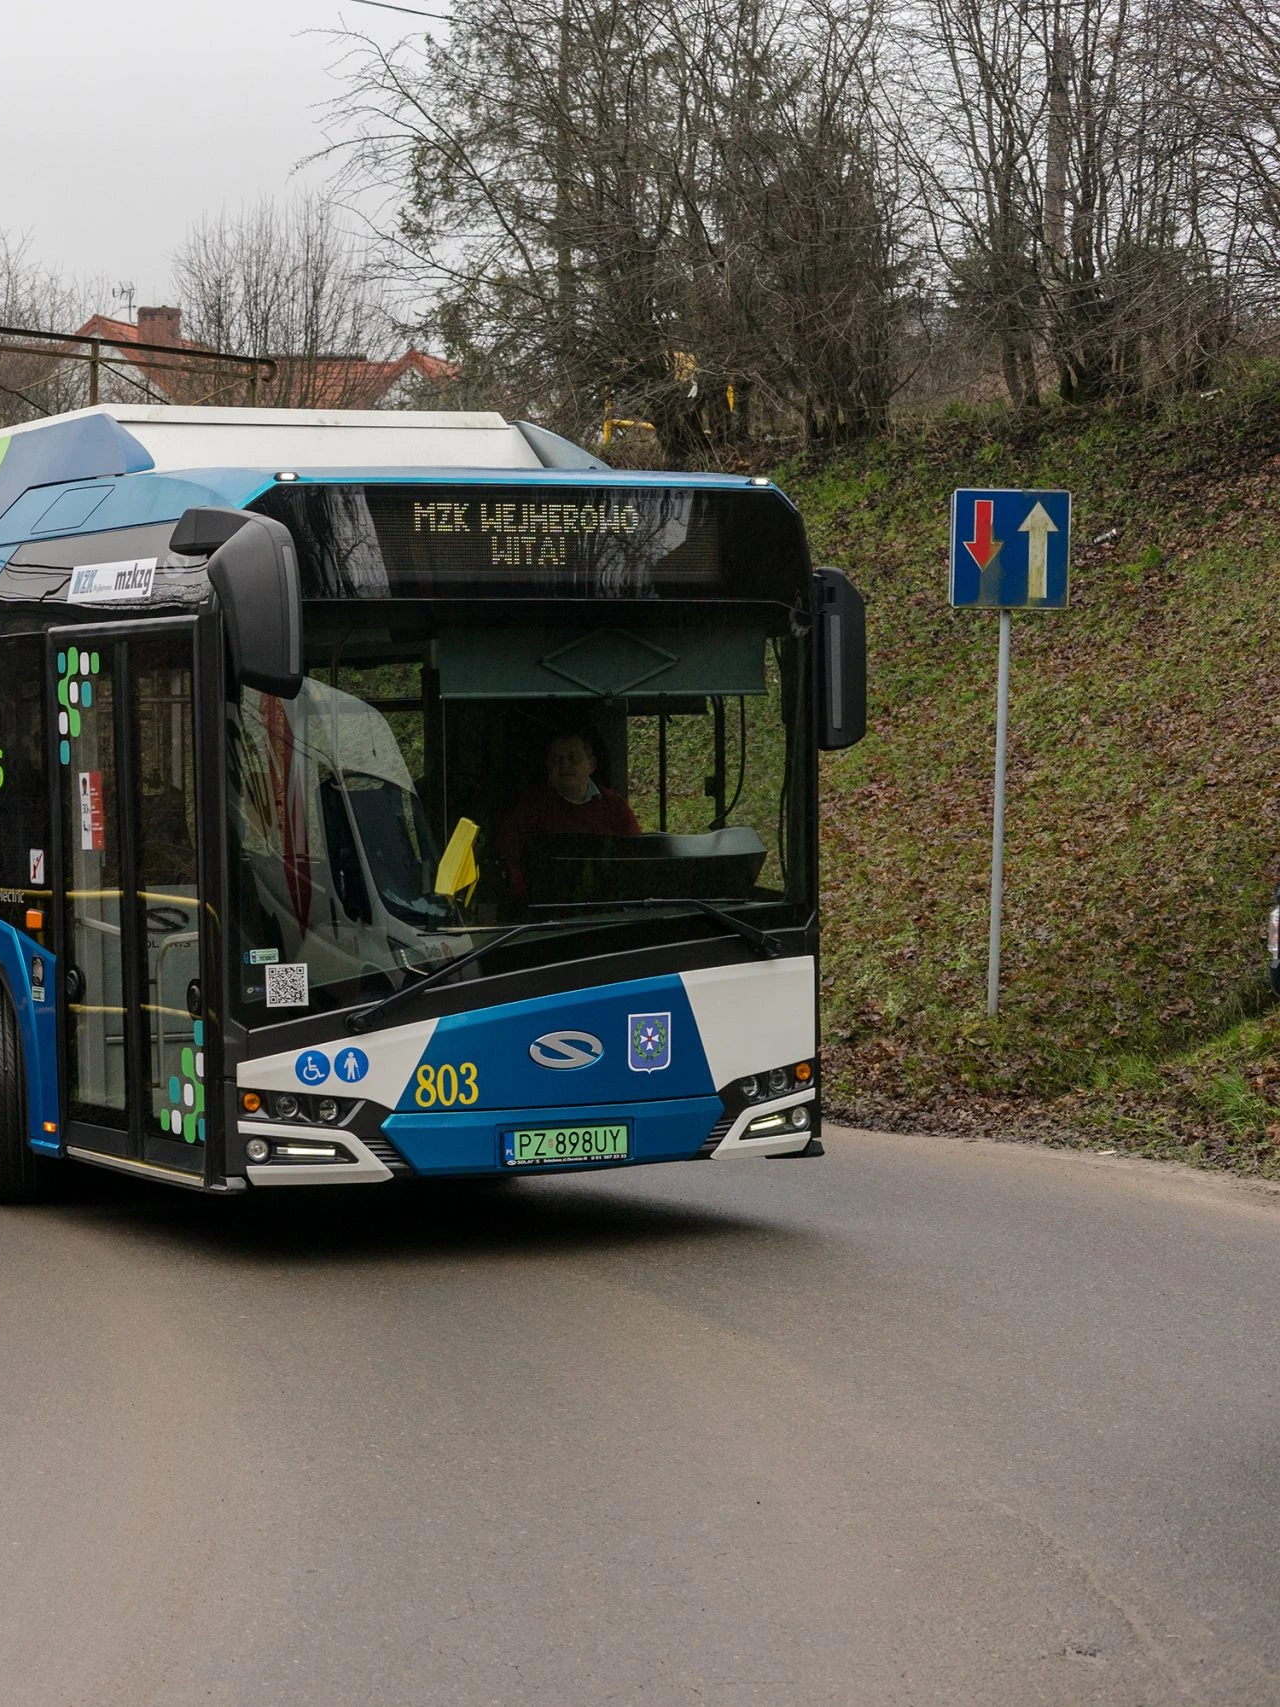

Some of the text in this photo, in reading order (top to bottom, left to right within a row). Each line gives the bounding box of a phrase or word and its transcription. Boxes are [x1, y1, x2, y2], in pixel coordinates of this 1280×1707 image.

[414, 503, 638, 533] MZK WEJHEROWO
[114, 563, 153, 595] mzkzg
[415, 1062, 479, 1108] 803
[519, 1129, 621, 1157] PZ 898UY
